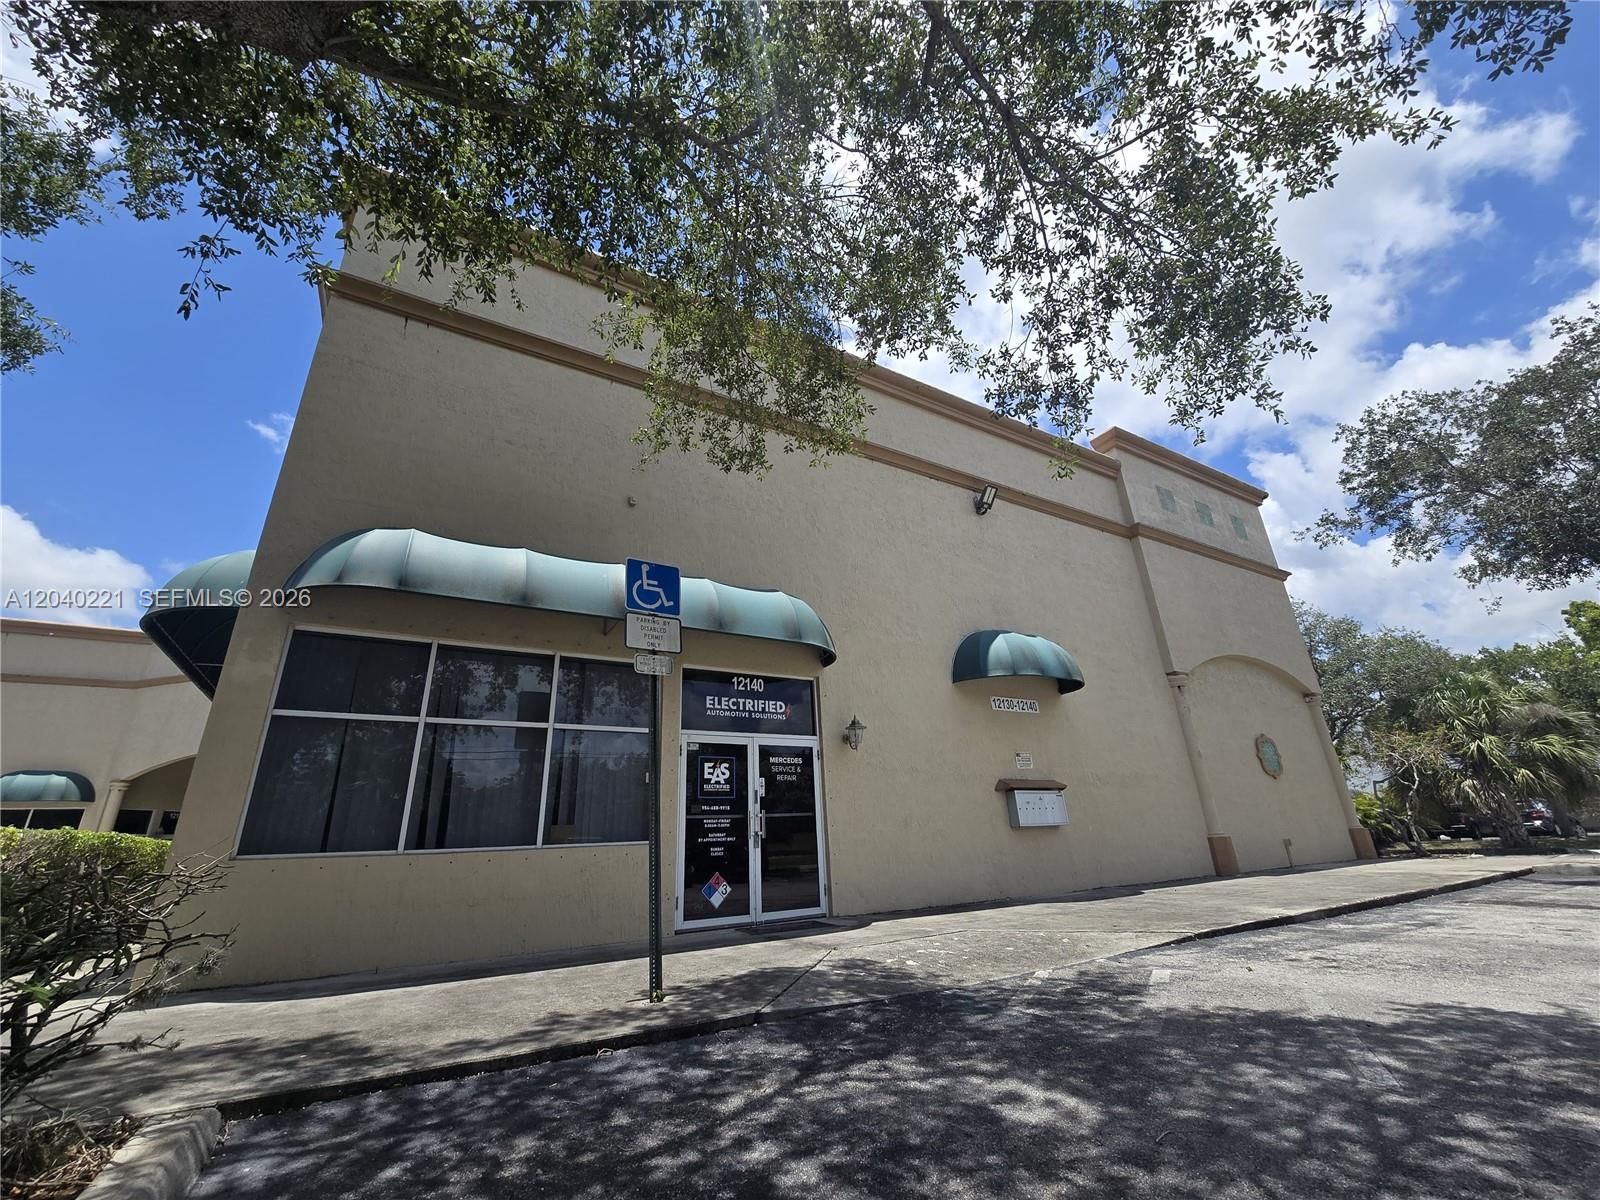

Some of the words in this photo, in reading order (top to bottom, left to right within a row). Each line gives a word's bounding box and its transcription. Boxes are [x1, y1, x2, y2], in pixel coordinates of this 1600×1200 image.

[636, 616, 660, 626] PARKING
[640, 625, 667, 634] DISABLED
[643, 633, 664, 641] PERMIT
[647, 641, 661, 649] ONLY
[732, 676, 764, 692] 12140
[706, 695, 786, 713] ELECTRIFIED
[992, 698, 1038, 712] 12130-12140
[706, 709, 749, 718] AUTOMOTIVE
[751, 712, 786, 720] SOLUTIONS
[769, 756, 803, 764] MERCEDES
[703, 762, 730, 784] EAS
[771, 765, 796, 773] SERVICE
[721, 884, 728, 895] 3
